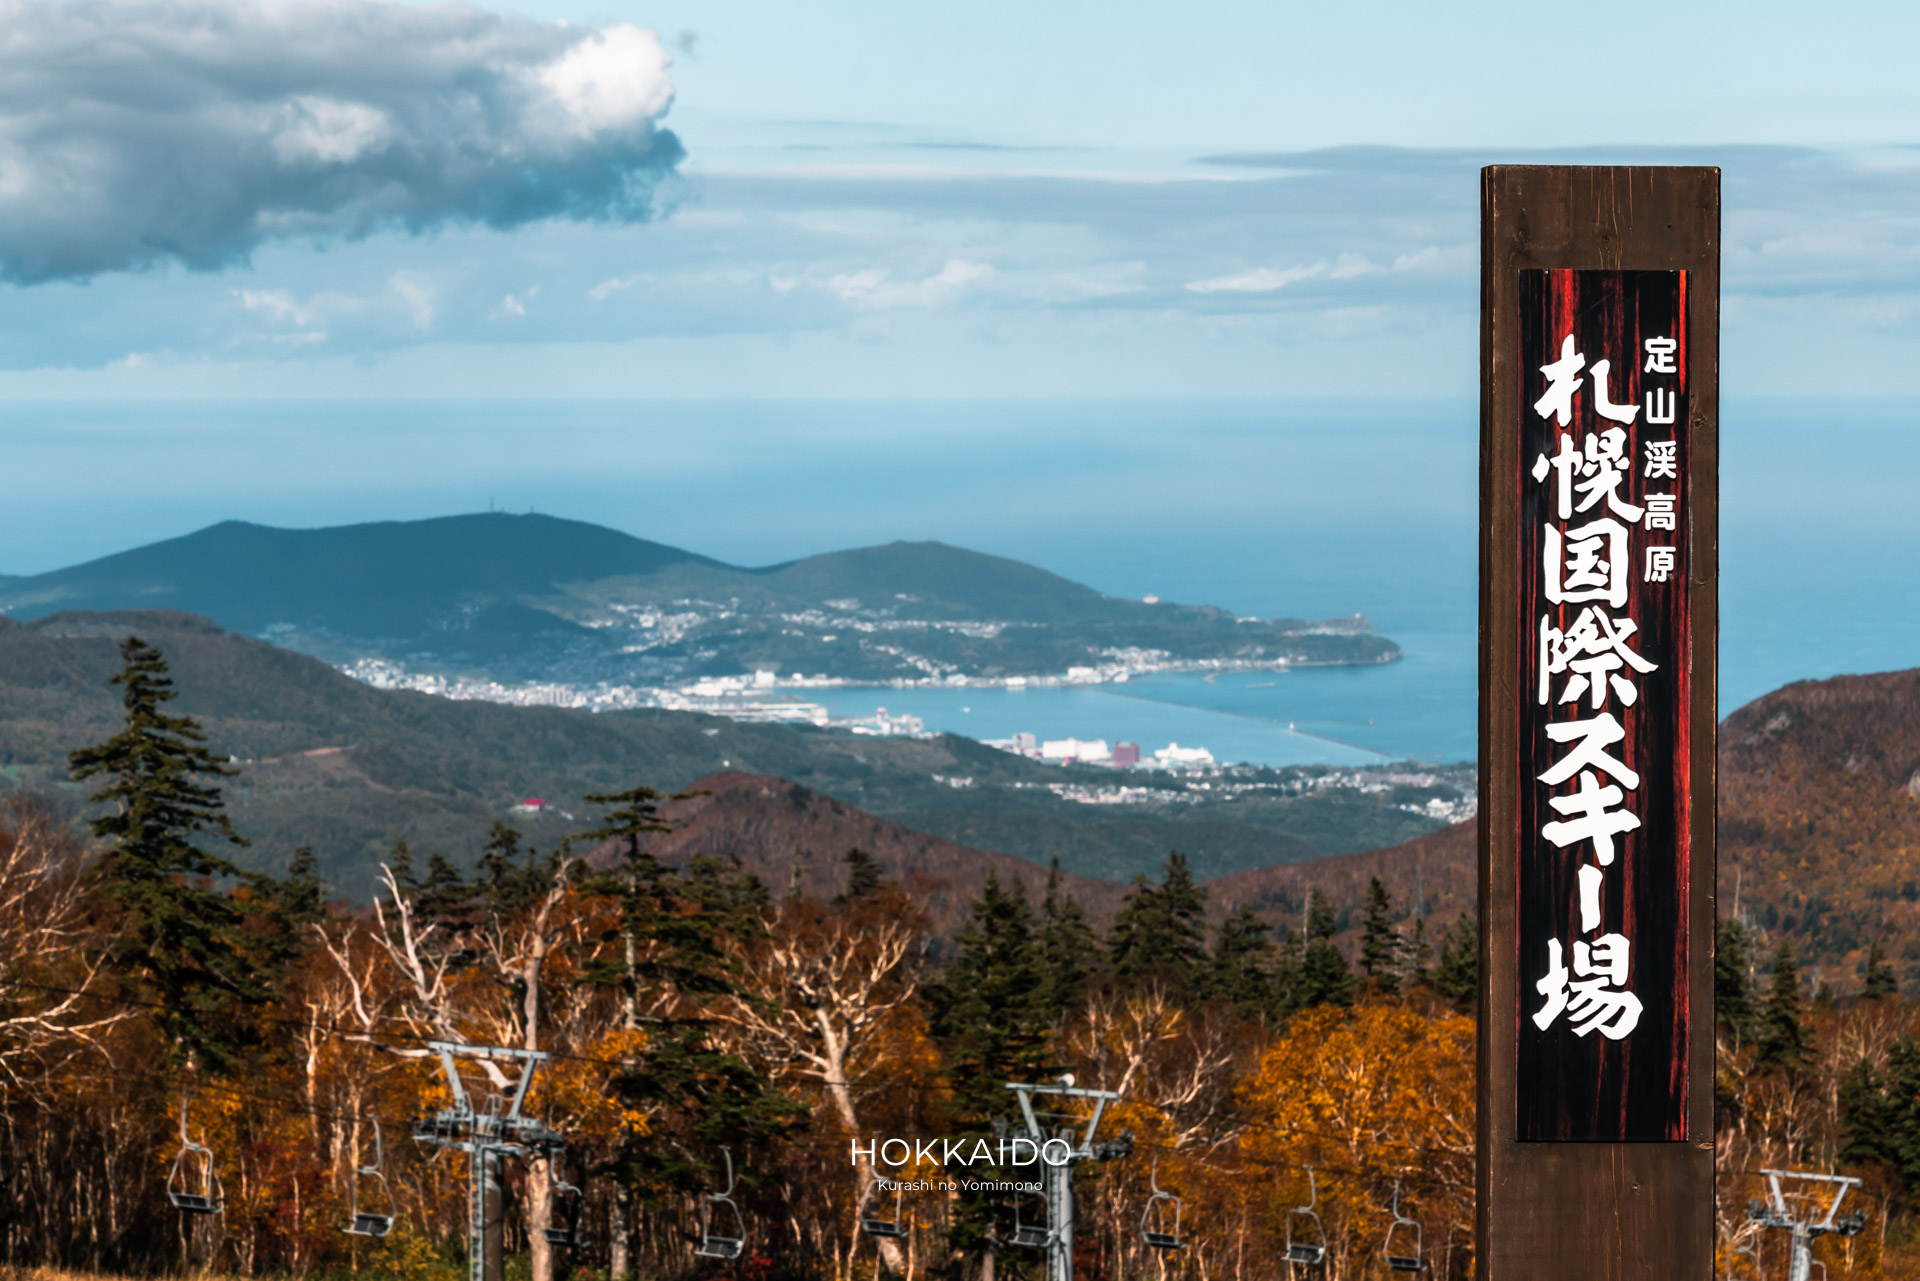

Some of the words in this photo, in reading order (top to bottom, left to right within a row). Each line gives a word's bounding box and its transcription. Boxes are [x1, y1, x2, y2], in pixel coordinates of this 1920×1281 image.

[1531, 333, 1659, 1041] 札幌国際スキー場
[1643, 335, 1677, 583] 定山渓高原
